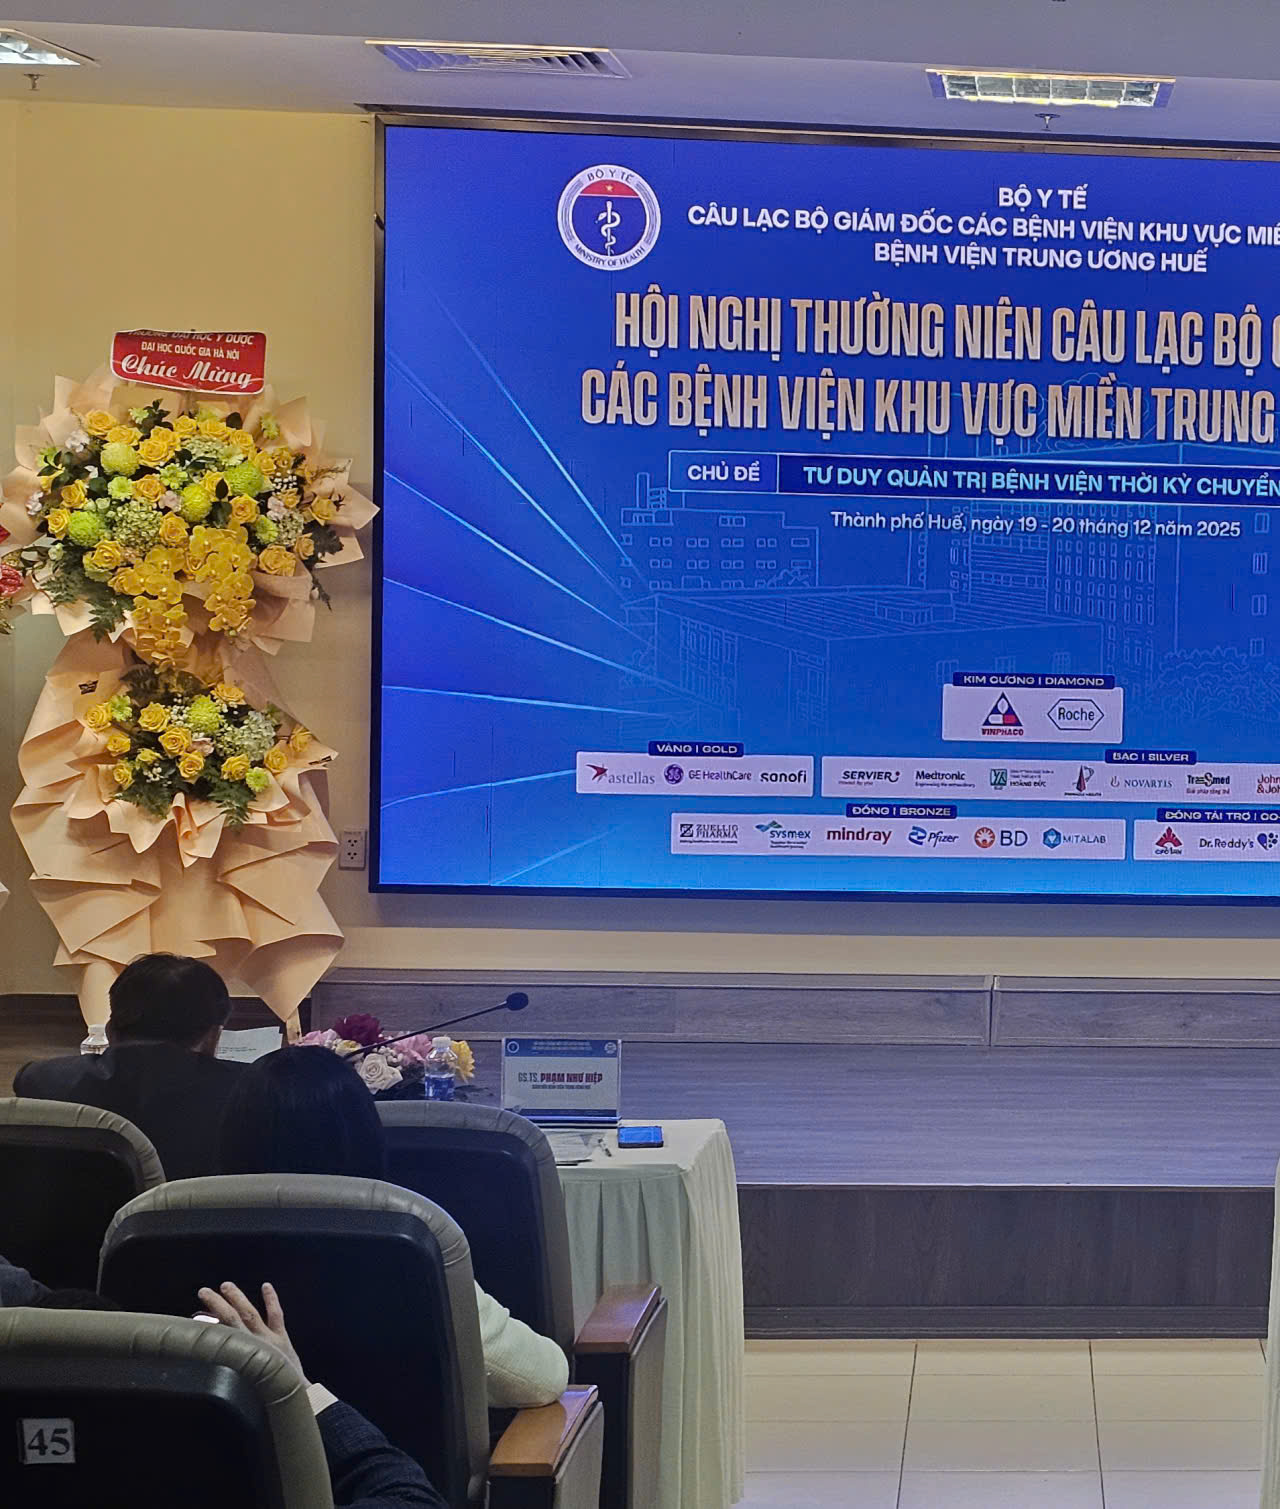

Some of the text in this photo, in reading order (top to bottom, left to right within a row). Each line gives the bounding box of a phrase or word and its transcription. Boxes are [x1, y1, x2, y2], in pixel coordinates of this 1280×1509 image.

[999, 183, 1088, 210] BỘ Y TẾ
[688, 204, 738, 227] CÂU
[743, 209, 790, 231] LẠC
[795, 206, 830, 234] BỘ
[834, 207, 896, 233] GIÁM
[900, 208, 954, 236] ĐỐC
[958, 210, 1009, 237] CÁC
[1013, 216, 1075, 243] BỆNH
[1081, 217, 1134, 244] VIỆN
[1140, 220, 1188, 243] KHU
[1194, 221, 1242, 248] VỰC
[875, 240, 1208, 273] BỆNH VIỆN TRUNG ƯƠNG HUẾ
[615, 283, 679, 359] HỘI
[689, 294, 781, 362] NGHỊ
[790, 291, 945, 358] THƯỜNG
[955, 295, 1041, 361] NIÊN
[1052, 299, 1127, 364] CÂU
[1135, 310, 1203, 374] LẠC
[1213, 304, 1262, 377] BỘ
[215, 333, 224, 342] Y
[157, 342, 172, 354] HỌC
[198, 347, 212, 357] GIA
[213, 346, 225, 359] HÀ
[121, 354, 253, 389] Chúc Mừng
[581, 359, 658, 426] CÁC
[668, 363, 768, 437] BỆNH
[778, 367, 865, 440] VIỆN
[875, 378, 950, 435] KHU
[962, 377, 1037, 446] VỰC
[1047, 372, 1142, 441] MIỀN
[1151, 387, 1275, 443] TRUNG
[687, 460, 729, 482] CHỦ
[803, 465, 834, 485] TƯ
[837, 468, 882, 487] DUY
[887, 465, 949, 489] QUẢN
[953, 470, 987, 493] TRỊ
[992, 467, 1049, 495] BỆNH
[1053, 470, 1102, 496] VIỆN
[1108, 473, 1158, 494] THỜI
[831, 511, 1241, 538] Thành phố Huế, ngày 19 20 tháng 12 năm 2025
[963, 675, 987, 685] KIM
[1045, 677, 1105, 687] DIAMOND
[1058, 707, 1096, 722] Roche
[981, 727, 1024, 737] VINPHACO
[656, 743, 738, 754] VÀNG GOLD
[1148, 752, 1189, 762] SILVER
[608, 770, 655, 785] astellas
[688, 770, 752, 782] GE HealthCare
[760, 770, 808, 783] sanofi
[842, 770, 895, 781] SERVIER
[916, 770, 966, 780] Medtronic
[1124, 778, 1173, 788] NOVARTIS
[900, 806, 951, 817] BRONZE
[696, 830, 739, 839] PHARMA
[769, 829, 811, 840] sysmex
[826, 827, 893, 846] mindray
[927, 832, 959, 848] Pfizer
[1000, 830, 1028, 847] BD
[1062, 835, 1107, 844] MITALAB
[540, 1072, 565, 1084] PHẠM
[566, 1071, 585, 1083] NHƯ
[585, 1071, 603, 1085] HIỆP
[27, 1428, 71, 1456] 45
